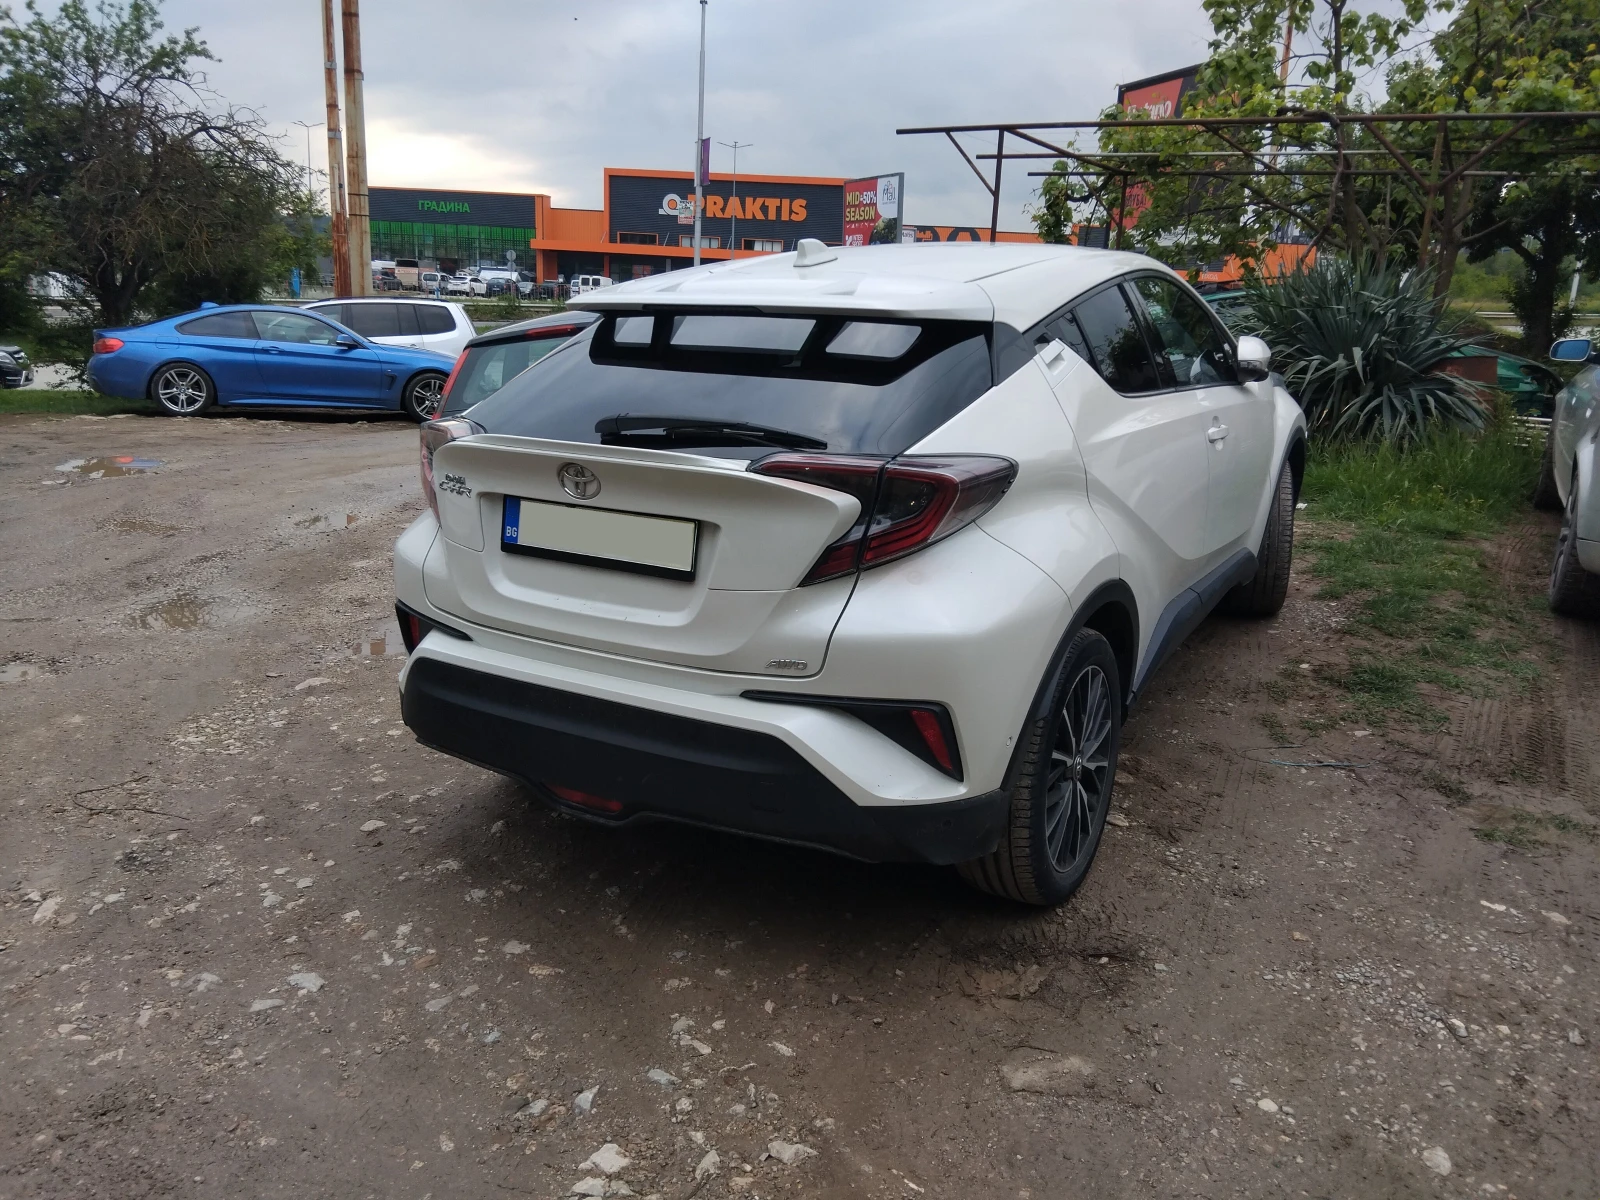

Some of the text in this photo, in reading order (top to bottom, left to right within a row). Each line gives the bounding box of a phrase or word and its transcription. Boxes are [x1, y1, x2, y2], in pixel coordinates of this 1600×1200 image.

[846, 191, 860, 206] MID
[418, 200, 471, 213] ГРАДИНА
[687, 194, 808, 222] PRAKTIS
[845, 206, 876, 222] SEASON
[506, 526, 518, 538] BG
